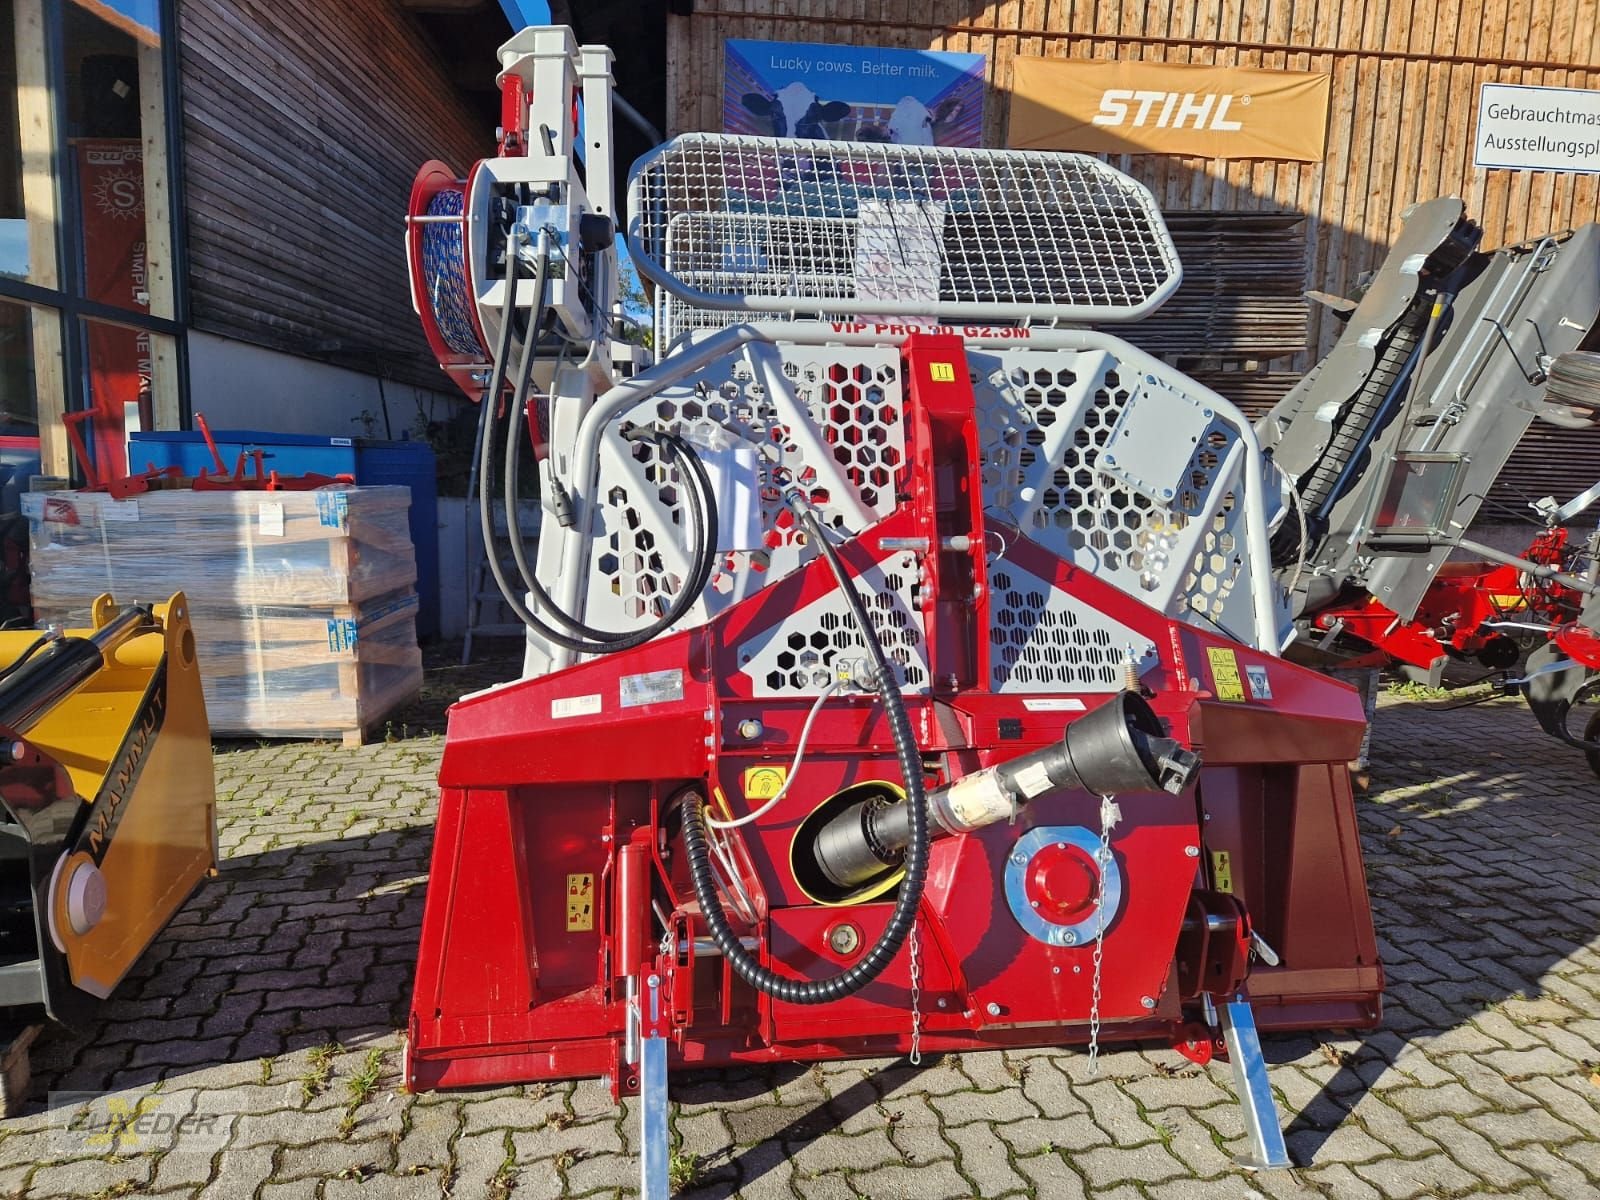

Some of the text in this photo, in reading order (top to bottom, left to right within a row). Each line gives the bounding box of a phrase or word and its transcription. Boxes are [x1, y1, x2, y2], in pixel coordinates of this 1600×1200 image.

[770, 55, 940, 78] Lucky cows. Better milk.
[1092, 89, 1243, 131] STIHL
[1484, 133, 1600, 158] Ausstellungspl
[831, 322, 867, 334] VIP
[875, 323, 921, 336] PRO
[963, 326, 1031, 339] G2.3M
[89, 687, 162, 854] MAMMUT
